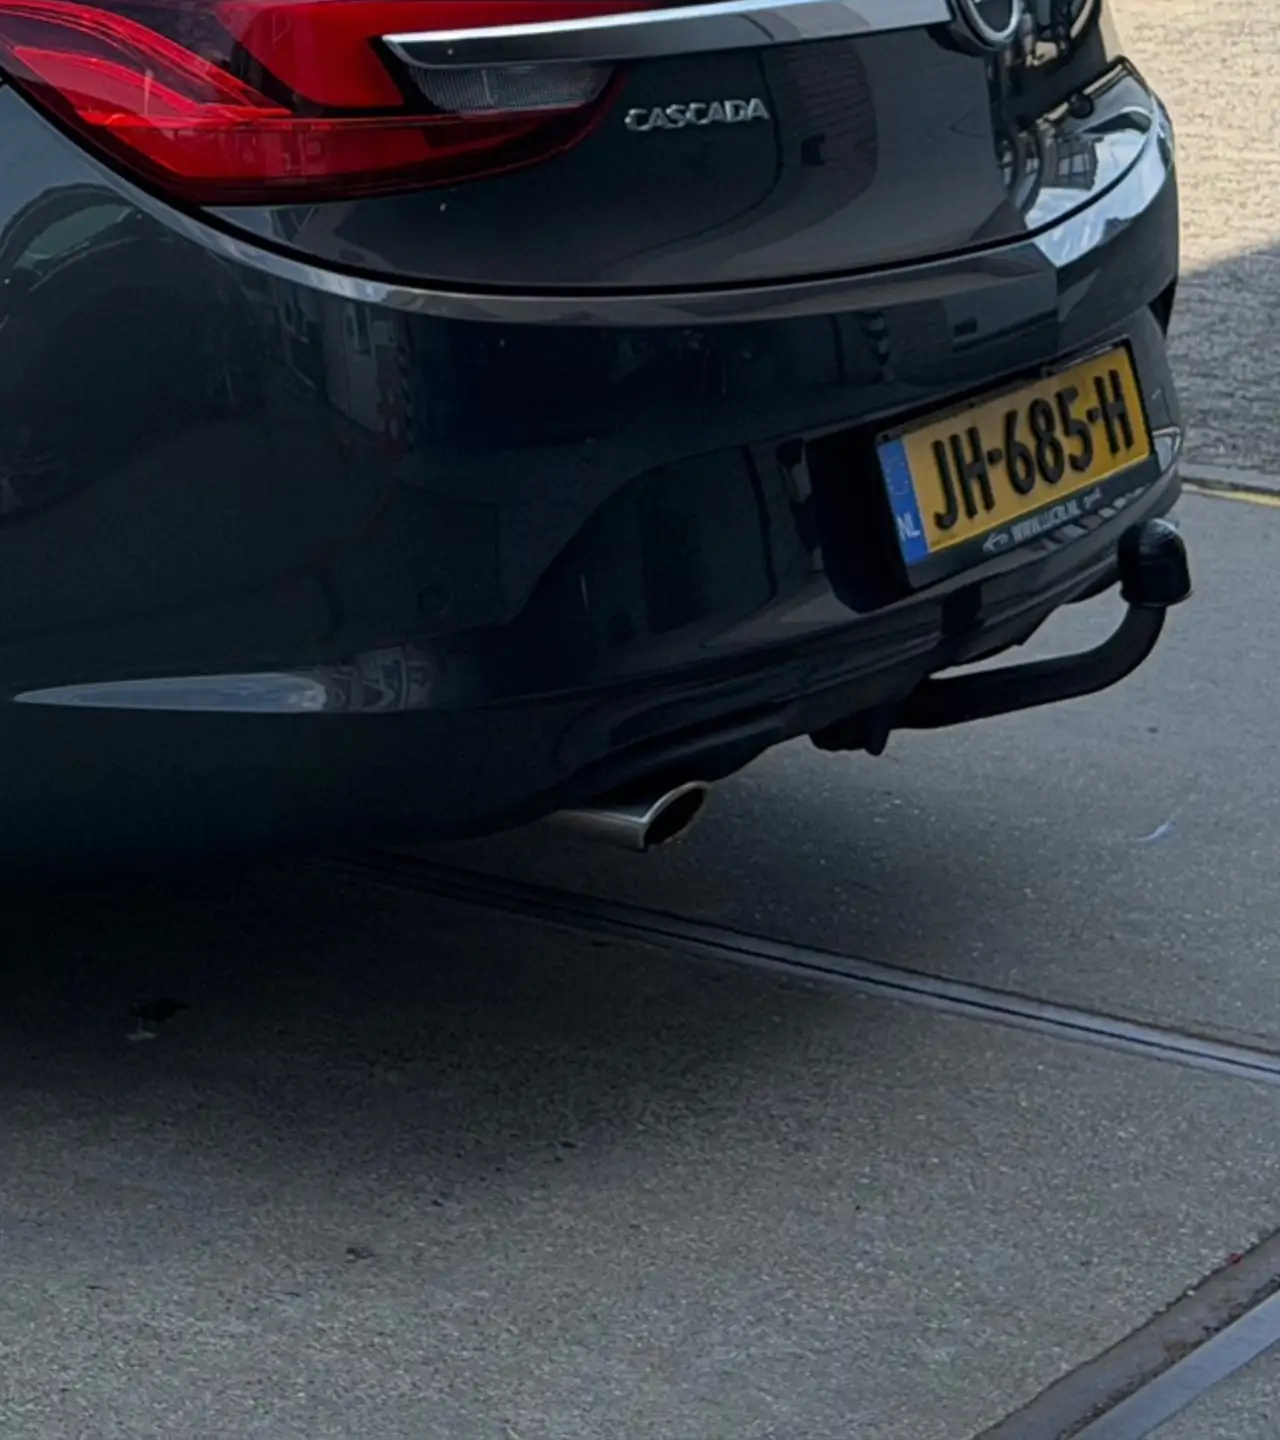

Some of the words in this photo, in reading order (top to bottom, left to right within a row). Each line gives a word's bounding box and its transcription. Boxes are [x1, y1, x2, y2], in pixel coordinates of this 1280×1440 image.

[624, 97, 771, 131] CASCADA
[895, 512, 921, 542] NL
[930, 369, 1135, 531] JH-685-H
